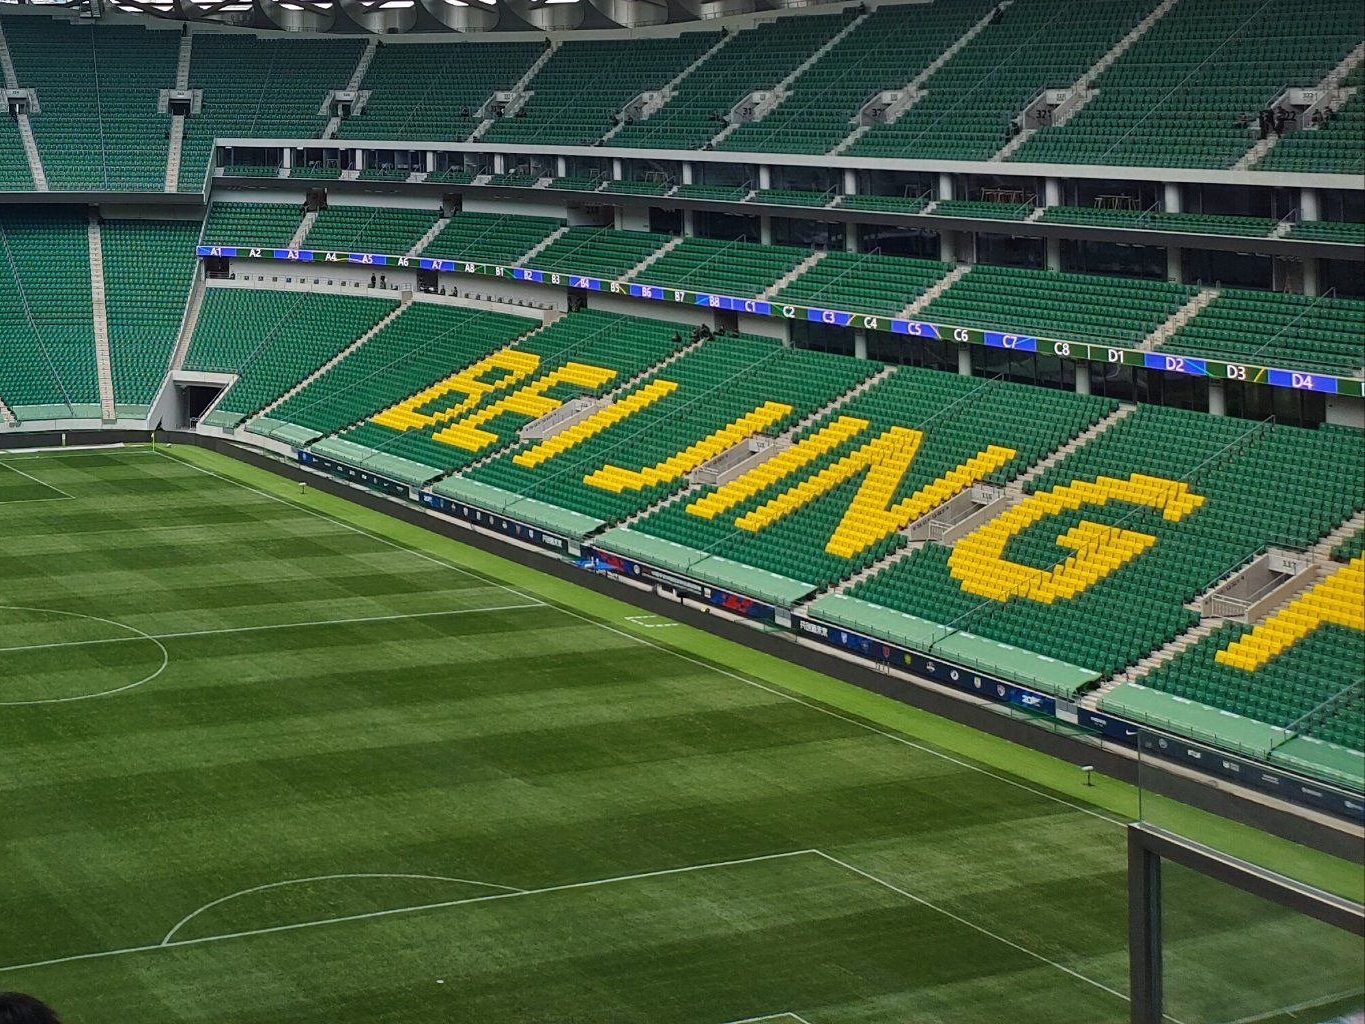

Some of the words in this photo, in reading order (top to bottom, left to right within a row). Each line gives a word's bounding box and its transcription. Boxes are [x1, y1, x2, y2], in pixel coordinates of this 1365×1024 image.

[210, 247, 222, 257] A1
[249, 248, 262, 258] A2
[287, 250, 299, 259] A3
[325, 252, 337, 262] A4
[362, 255, 373, 264] A5
[397, 257, 409, 267] A6
[431, 260, 442, 270] A7
[495, 267, 504, 276] B1
[523, 270, 533, 280] B2
[580, 279, 590, 288] B4
[641, 287, 652, 297] B6
[674, 291, 684, 302] B7
[709, 296, 720, 307] B8
[745, 301, 756, 312] C1
[783, 306, 795, 318] C2
[822, 311, 835, 323] C3
[864, 317, 877, 328] C4
[907, 323, 921, 335] C5
[953, 328, 968, 342] C6
[1002, 335, 1017, 349] C7
[1054, 342, 1070, 356] C8
[1108, 349, 1124, 363] D1
[1165, 356, 1184, 372] D2
[1226, 364, 1246, 380] D3
[1291, 373, 1313, 390] D4
[370, 348, 1206, 604] BEIJING
